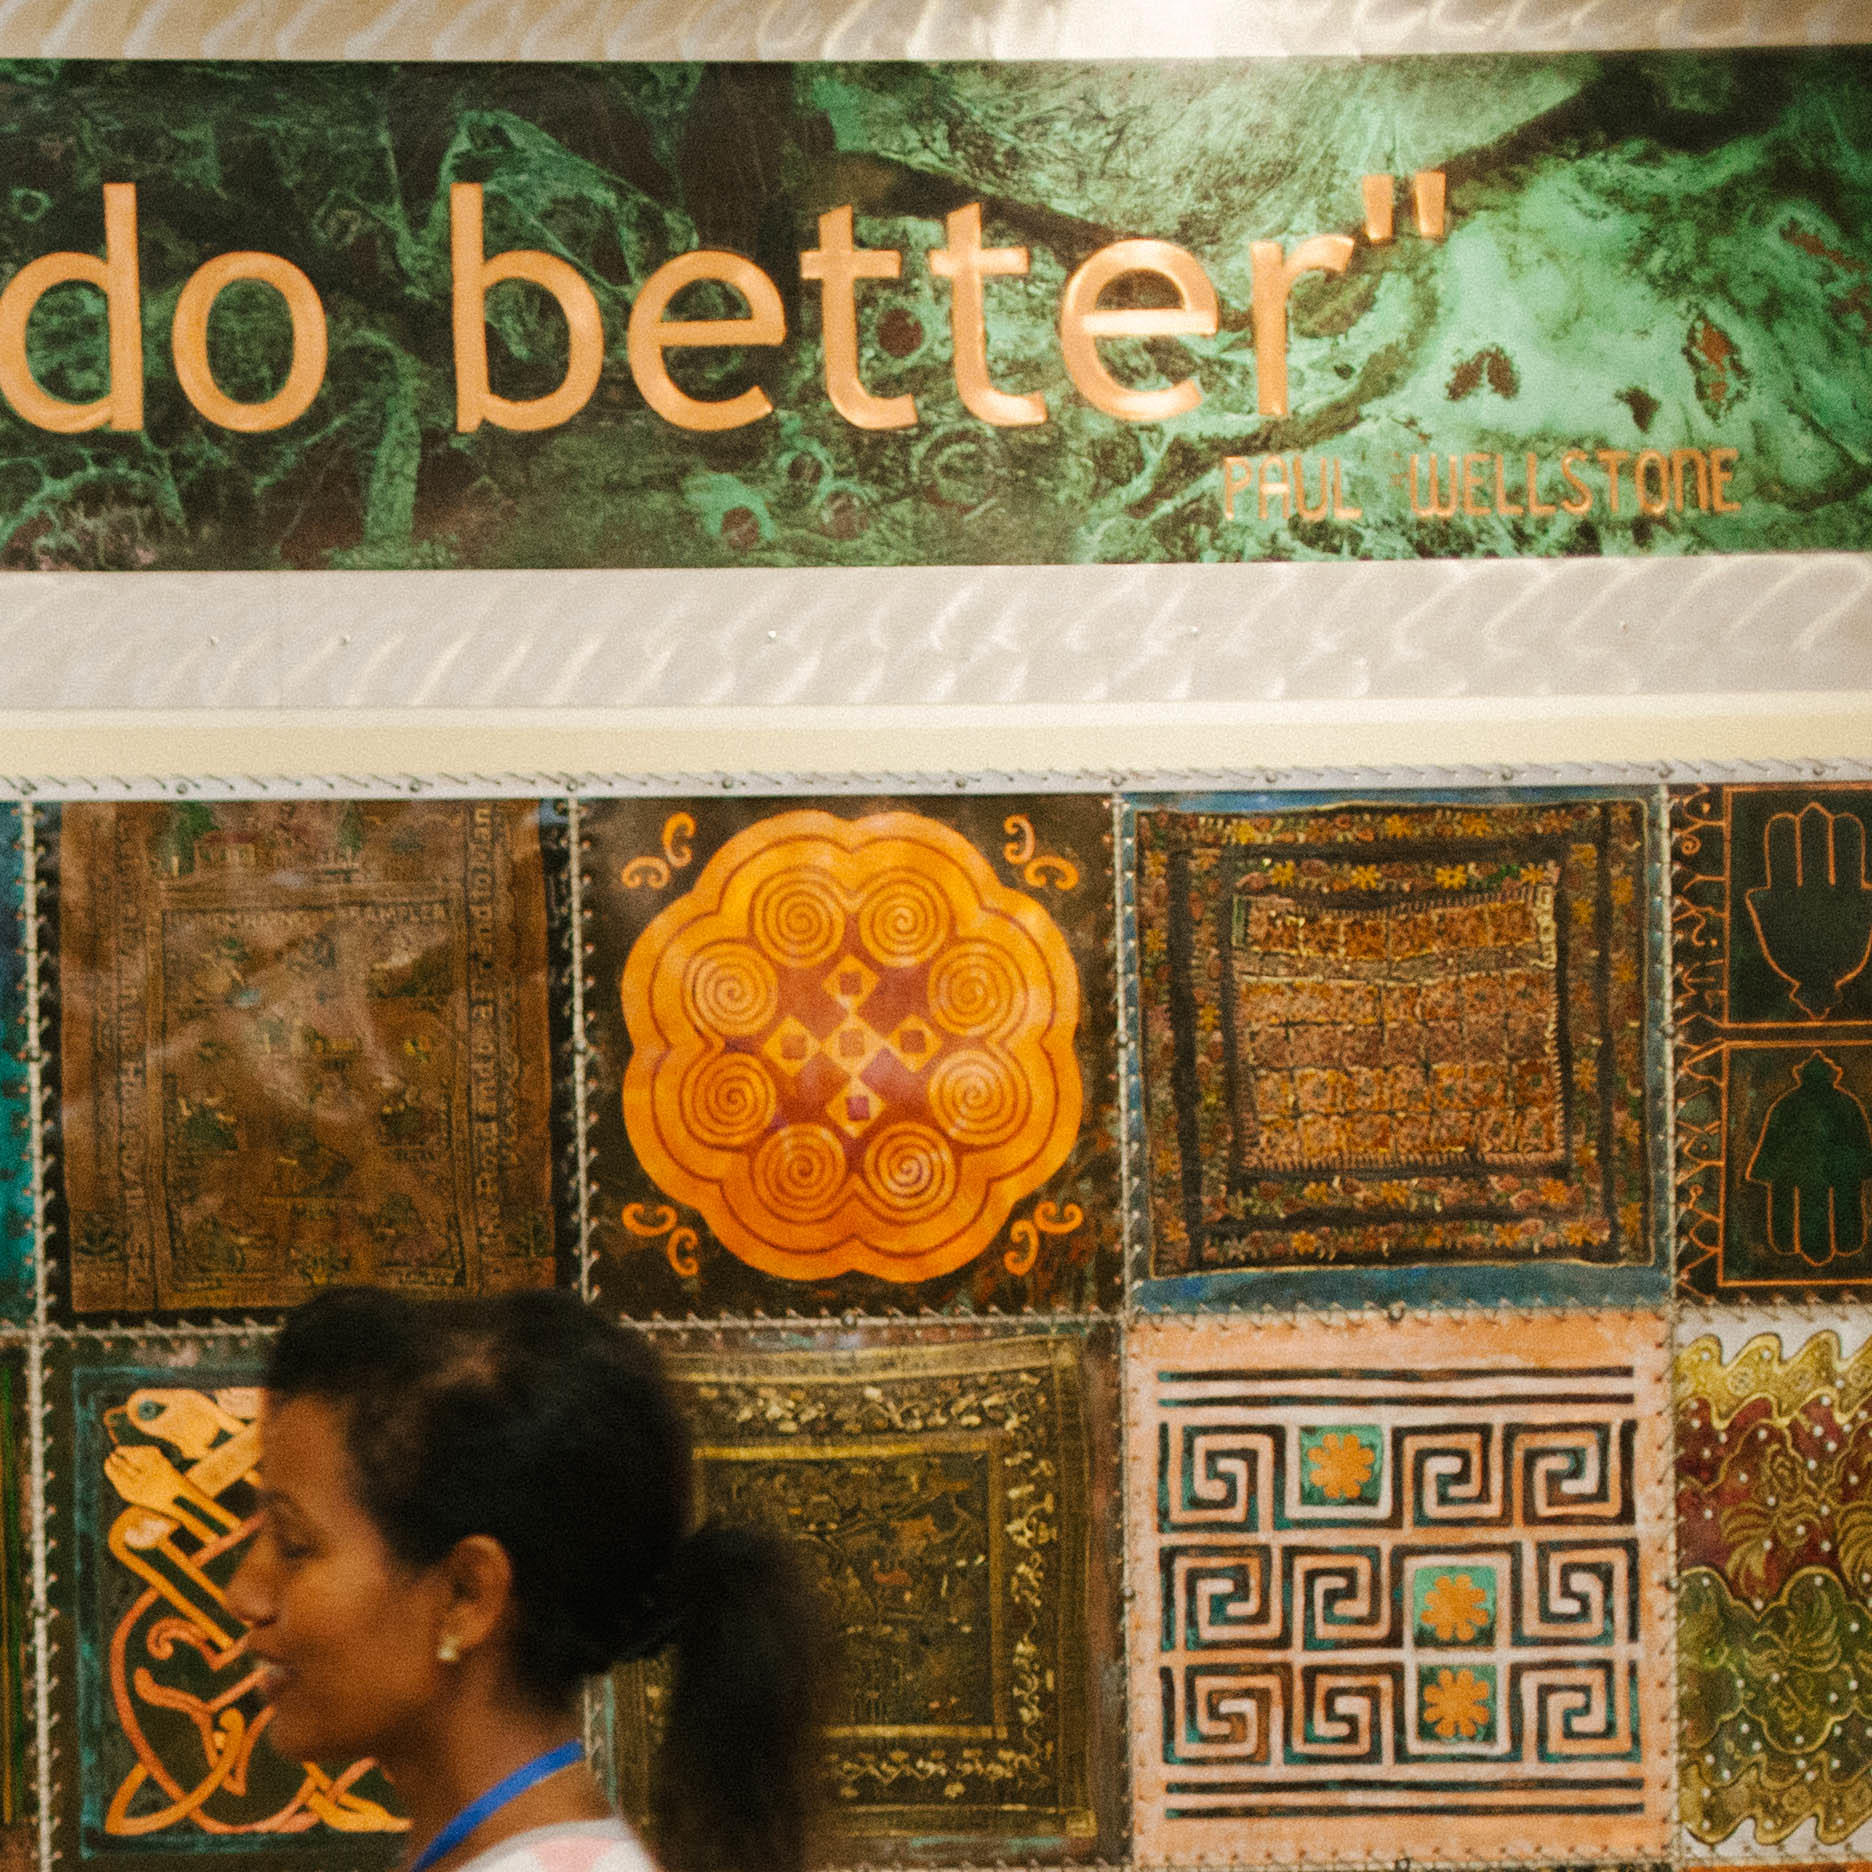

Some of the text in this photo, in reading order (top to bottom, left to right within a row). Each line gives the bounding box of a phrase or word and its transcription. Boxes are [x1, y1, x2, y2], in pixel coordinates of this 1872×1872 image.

[448, 168, 1448, 435] better"
[1221, 446, 1741, 522] PAUL WELLSTONE
